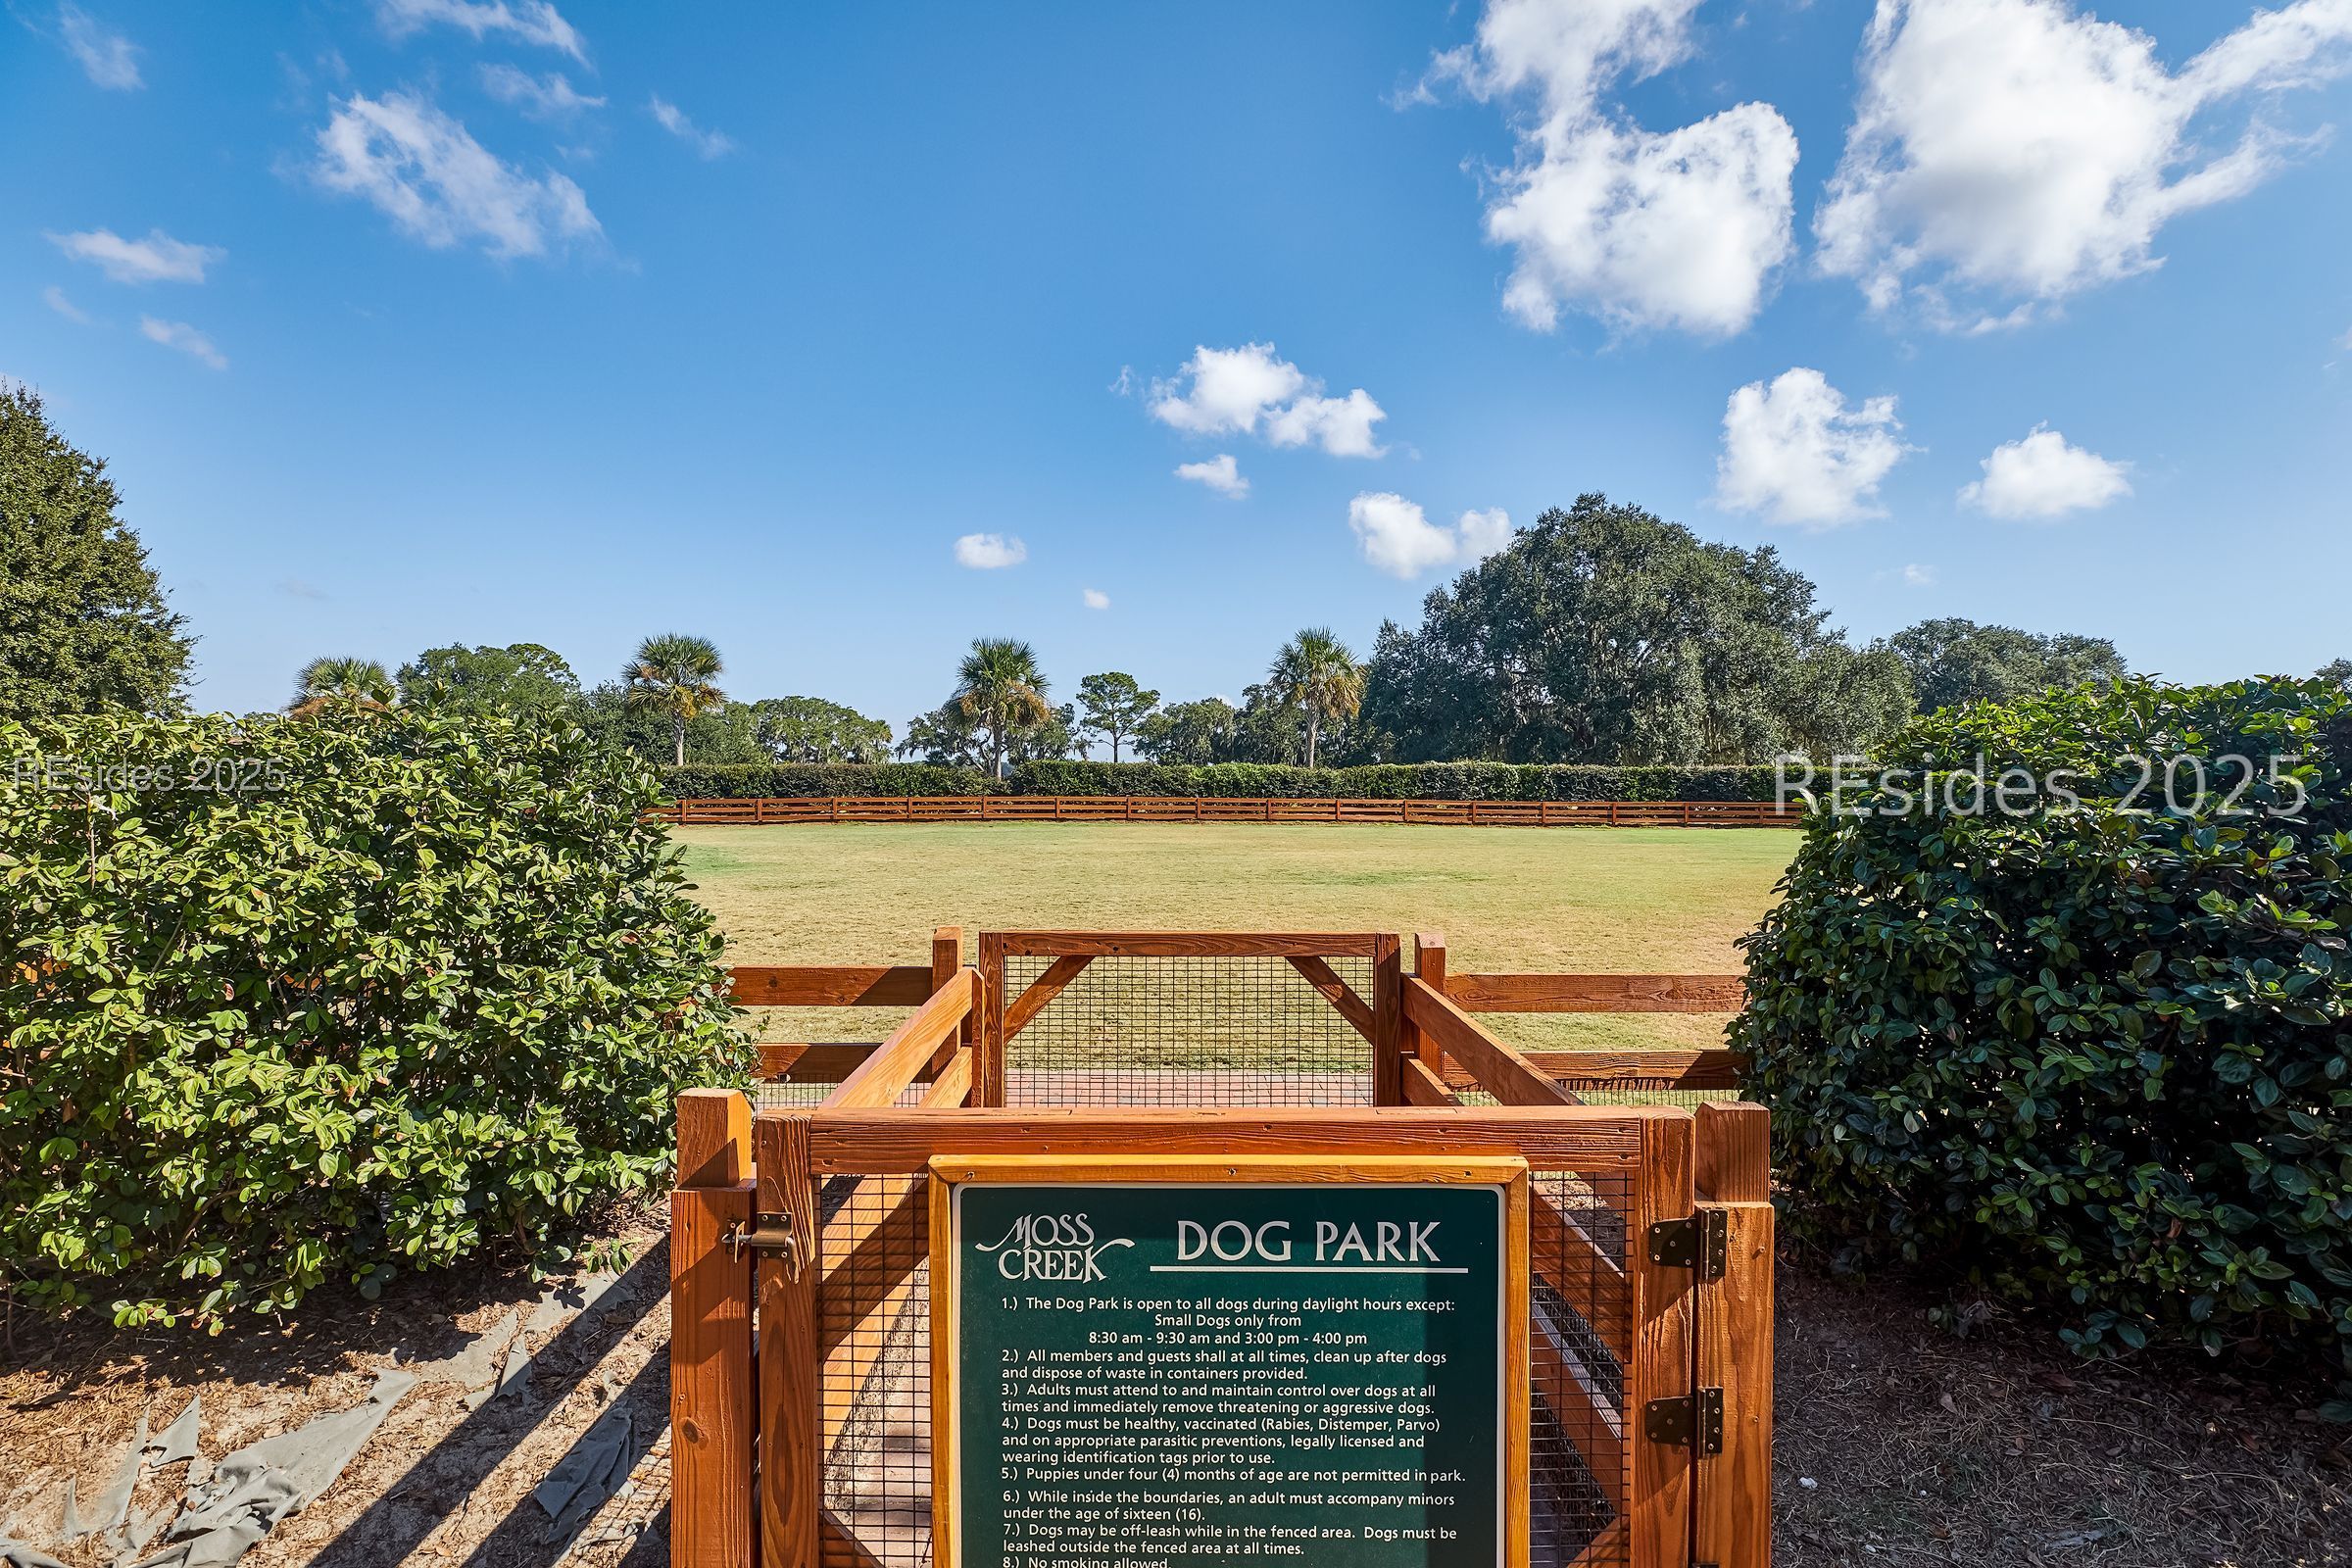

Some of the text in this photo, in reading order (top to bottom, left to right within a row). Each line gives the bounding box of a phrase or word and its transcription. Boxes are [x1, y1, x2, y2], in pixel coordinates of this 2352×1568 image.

[980, 1212, 1096, 1250] MOSS
[1177, 1220, 1442, 1262] DOG PARK
[998, 1242, 1133, 1284] CREEK
[1002, 1296, 1455, 1314] 1.) The Dog Park is open to all dogs during daylight hours except:
[1154, 1313, 1301, 1330] Small Dogs only from
[1088, 1331, 1118, 1344] 8:30
[1121, 1334, 1143, 1345] am
[1155, 1331, 1186, 1345] 9:30
[1189, 1334, 1210, 1345] am
[1214, 1331, 1241, 1345] and
[1245, 1332, 1274, 1345] 3:00
[1277, 1334, 1299, 1348] pm
[1311, 1332, 1342, 1345] 4:00
[1345, 1334, 1367, 1348] pm
[1002, 1348, 1446, 1367] 2.) All members and guests shall at all times, clean up after dogs
[1002, 1365, 1308, 1383] and dispose of waste in containers provided.
[1001, 1382, 1436, 1400] 3.) Adults must attend to and maintain control over dogs at all
[1001, 1399, 1435, 1417] times and immediately remove threatening or aggressive dogs.
[1001, 1416, 1441, 1434] 4.) Dogs must be healthy, vaccinated (Rabies, Distemper, Parvo)
[1002, 1433, 1425, 1450] and on appropriate parasitic preventions, legally licensed and
[1002, 1449, 1275, 1467] wearing identification tags prior to use.
[1001, 1466, 1466, 1485] 5.) Puppies under four (4) months of age are not permitted in park.
[1003, 1489, 1455, 1508] 6.) While inside the boundaries, an adult must accompany minors
[1004, 1505, 1205, 1523] under the age of sixteen (16).
[1003, 1522, 1457, 1543] 7.) Dogs may be off-leash while in the fenced area. Dogs must be
[1004, 1539, 1304, 1555] leashed outside the fenced area at all times.
[1028, 1556, 1048, 1568] No
[1051, 1556, 1109, 1568] smoking
